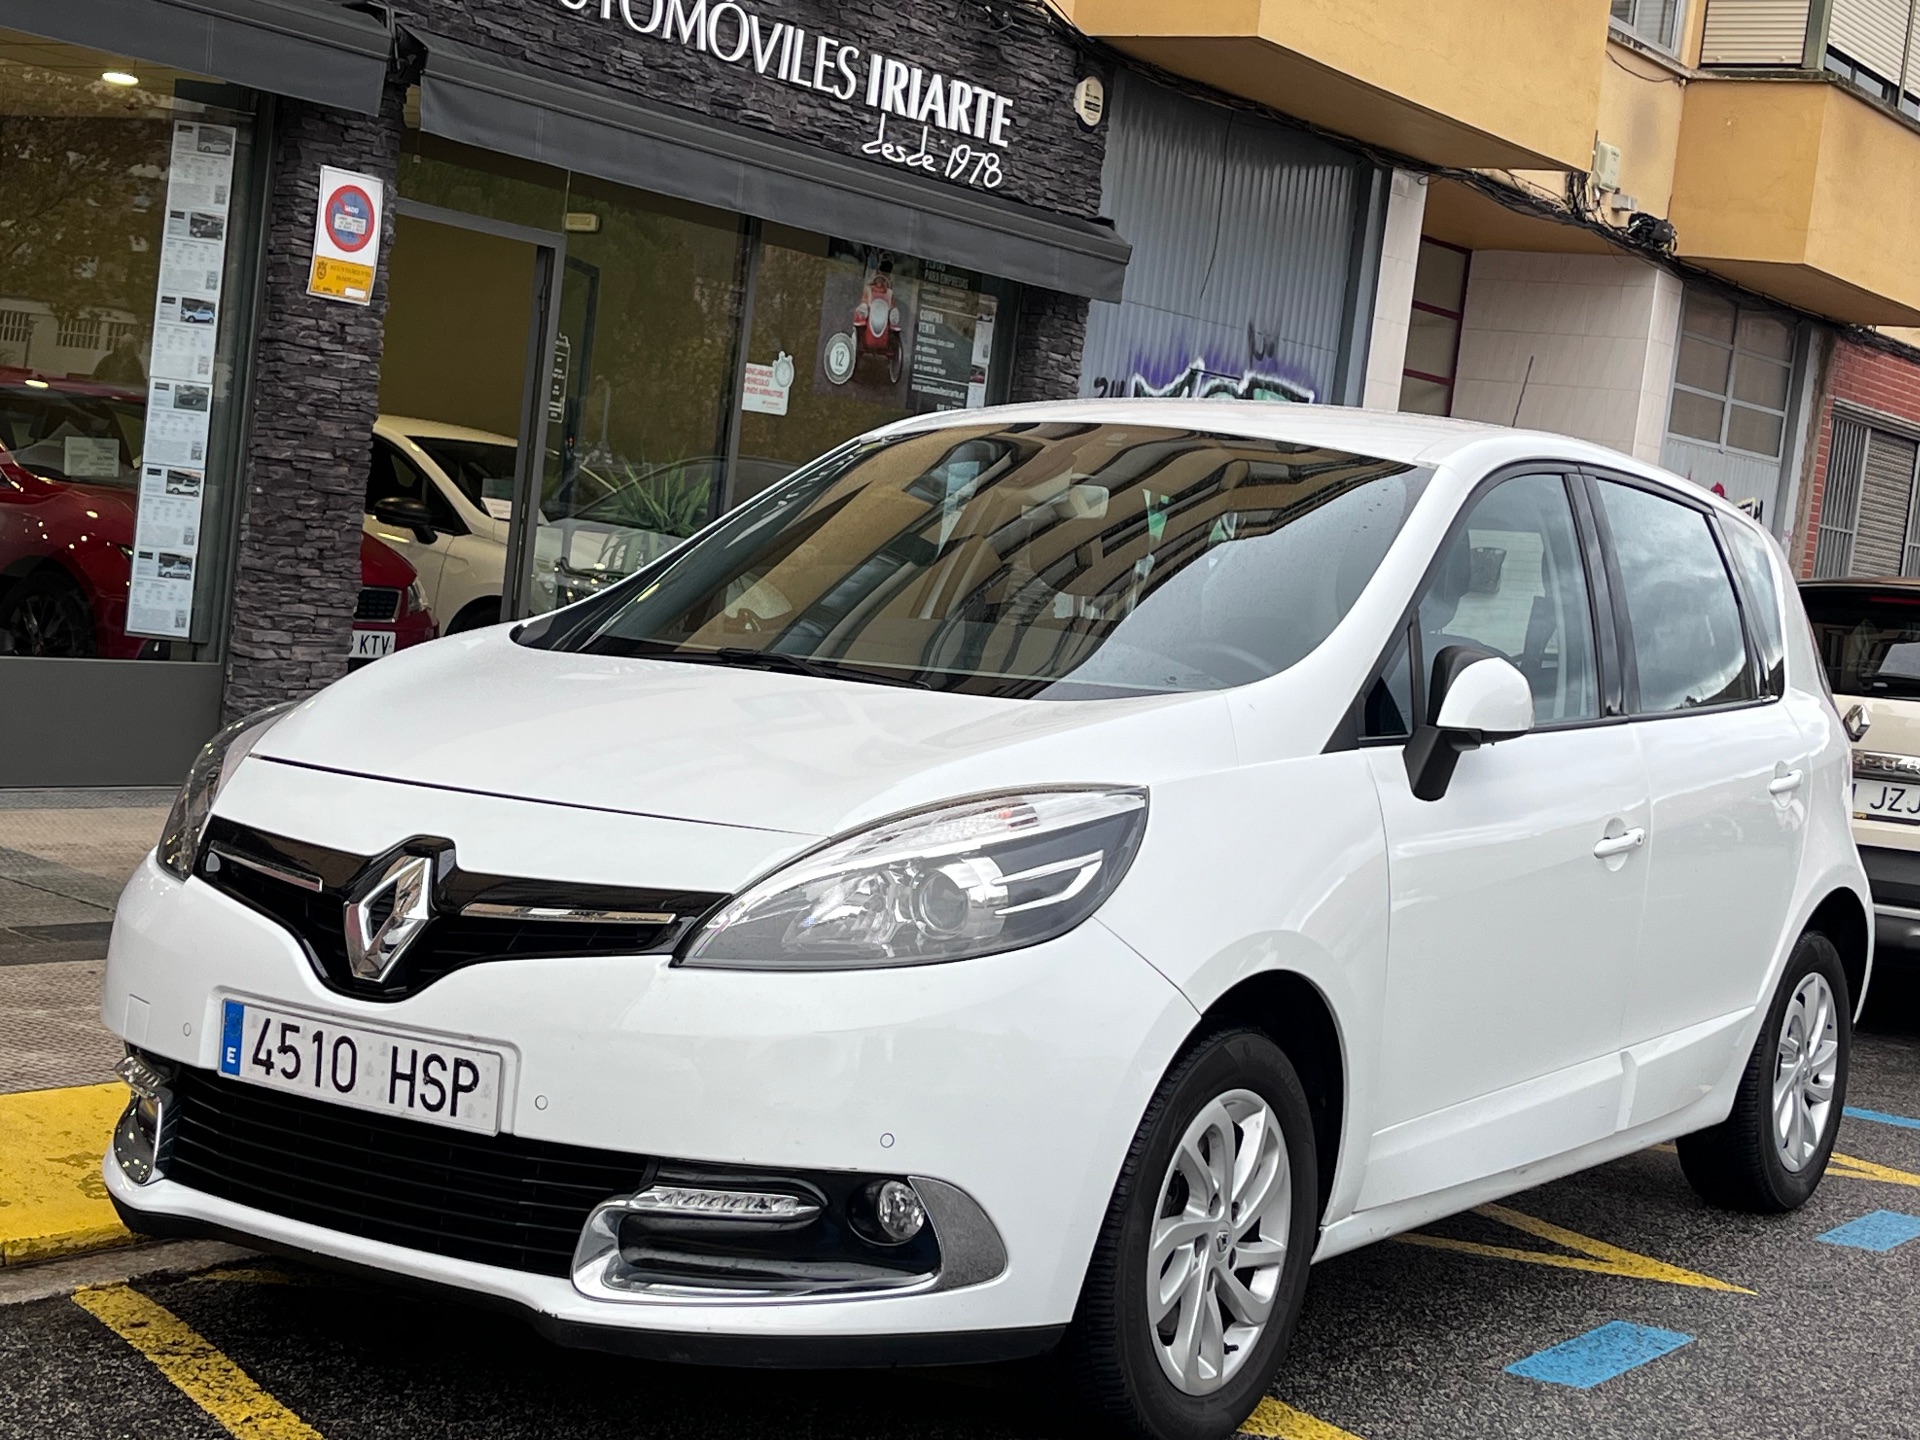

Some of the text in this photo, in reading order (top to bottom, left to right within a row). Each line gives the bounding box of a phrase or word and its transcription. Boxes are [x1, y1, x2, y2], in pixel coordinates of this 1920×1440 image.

[558, 0, 1014, 148] OMÓVILES IRIARTE
[861, 112, 1003, 188] desde 1978
[920, 309, 944, 324] COMPRA
[835, 350, 845, 367] 12
[359, 634, 391, 656] KTV
[1869, 786, 1920, 814] JZJ
[226, 1046, 237, 1065] E
[252, 1017, 481, 1118] 4510 HSP
